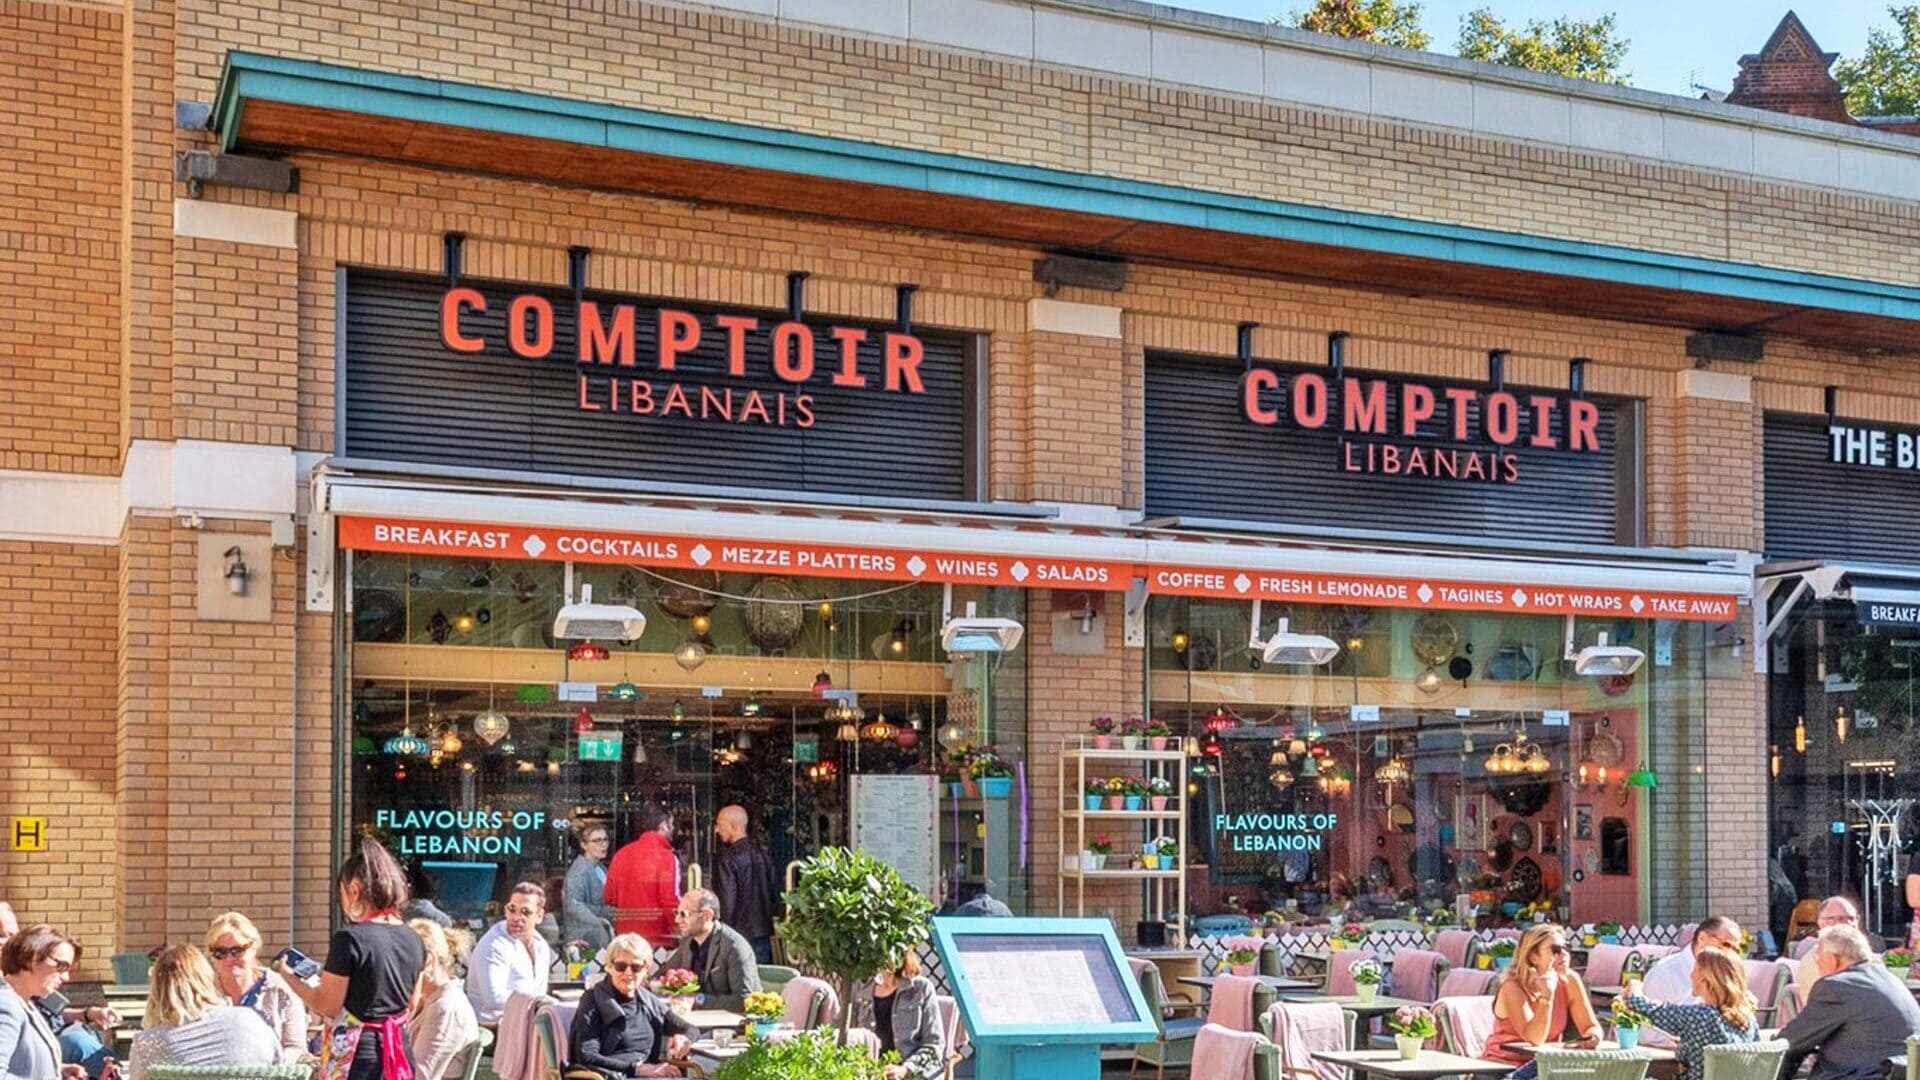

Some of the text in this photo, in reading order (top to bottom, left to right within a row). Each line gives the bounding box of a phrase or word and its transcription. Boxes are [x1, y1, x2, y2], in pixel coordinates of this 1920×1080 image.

[441, 287, 925, 393] COMPTOIR
[579, 375, 815, 428] LIBANAIS
[1244, 368, 1600, 452] COMPTOIR
[1344, 439, 1519, 483] LIBANAIS
[1829, 425, 1920, 470] THE B
[373, 524, 1109, 584] BREAKFAST COCKTAILS MEZZE PLATTERS WINES SALADS
[1157, 571, 1731, 616] COFFEE FRESH LEMONADE TAGINES HOT WRAPS TAKE AWAY
[16, 820, 39, 847] H
[376, 810, 545, 830] FLAVOURS OF
[1215, 813, 1337, 831] FLAVOURS OF
[401, 835, 522, 855] LEBANON
[1233, 834, 1321, 851] LEBANON
